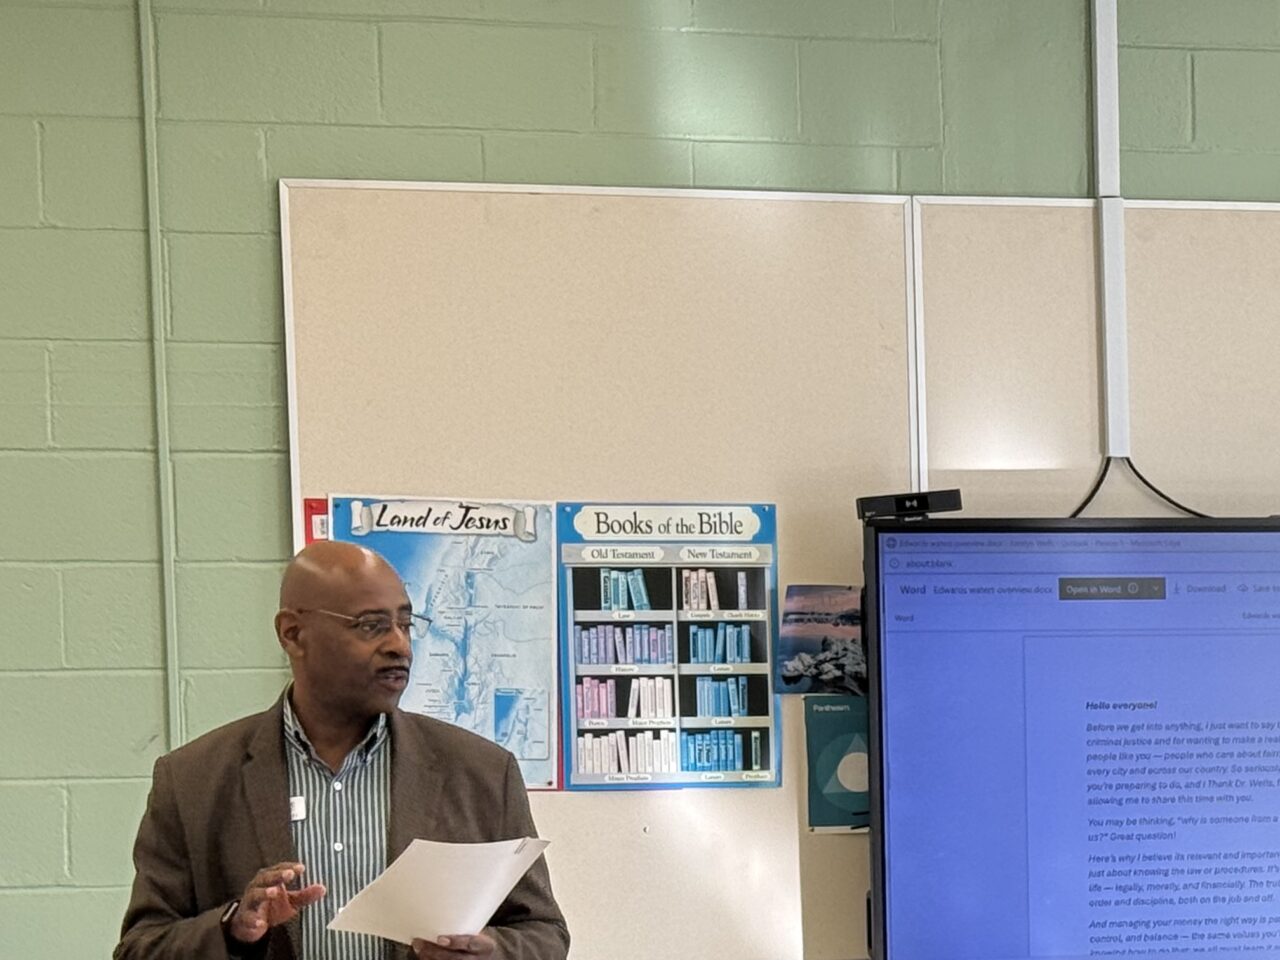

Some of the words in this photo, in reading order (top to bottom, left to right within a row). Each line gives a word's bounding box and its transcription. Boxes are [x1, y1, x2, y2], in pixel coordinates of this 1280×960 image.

[376, 504, 432, 528] Land
[433, 511, 452, 526] of
[450, 502, 510, 531] Jesus
[594, 510, 653, 534] Books
[658, 517, 673, 534] of
[676, 518, 695, 534] the
[698, 512, 743, 534] Bible
[591, 549, 608, 559] Old
[611, 549, 655, 559] Testament
[687, 549, 707, 559] New
[711, 549, 752, 559] Testament
[900, 585, 926, 594] Word
[933, 585, 967, 594] Edwards
[1066, 585, 1088, 595] Open
[1101, 585, 1121, 593] Word
[1186, 585, 1226, 593] Download
[1253, 584, 1270, 592] Save
[1086, 701, 1110, 710] Hello
